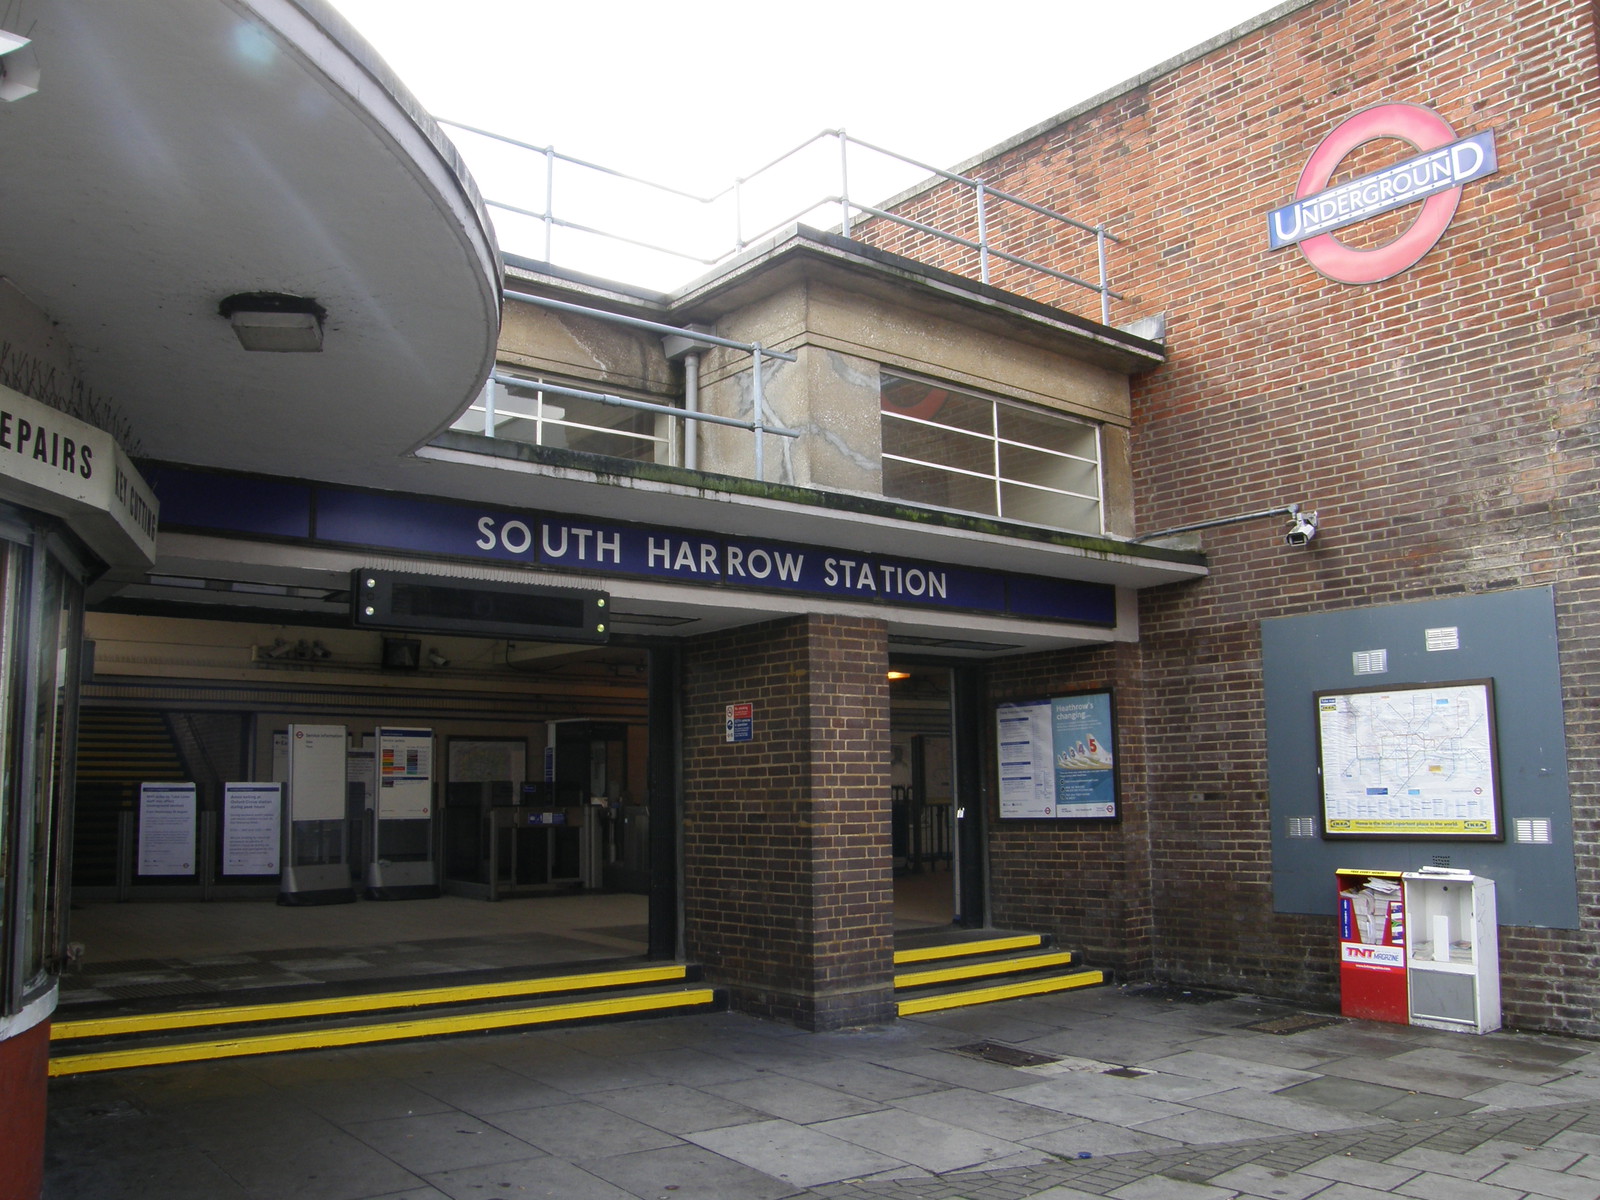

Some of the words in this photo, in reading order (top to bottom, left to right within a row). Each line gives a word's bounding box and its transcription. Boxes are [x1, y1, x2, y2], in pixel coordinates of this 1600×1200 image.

[1275, 141, 1484, 241] UNDERGROUND
[115, 464, 128, 507] KEY
[130, 485, 157, 542] CUTTING
[476, 516, 621, 564] SOUTH
[647, 537, 804, 582] HARROW
[823, 557, 947, 599] STATION
[1070, 749, 1076, 758] 3
[1078, 744, 1085, 755] 4
[1089, 739, 1097, 753] 5
[1346, 947, 1375, 958] TNT
[1374, 953, 1398, 961] MAGAZINE
